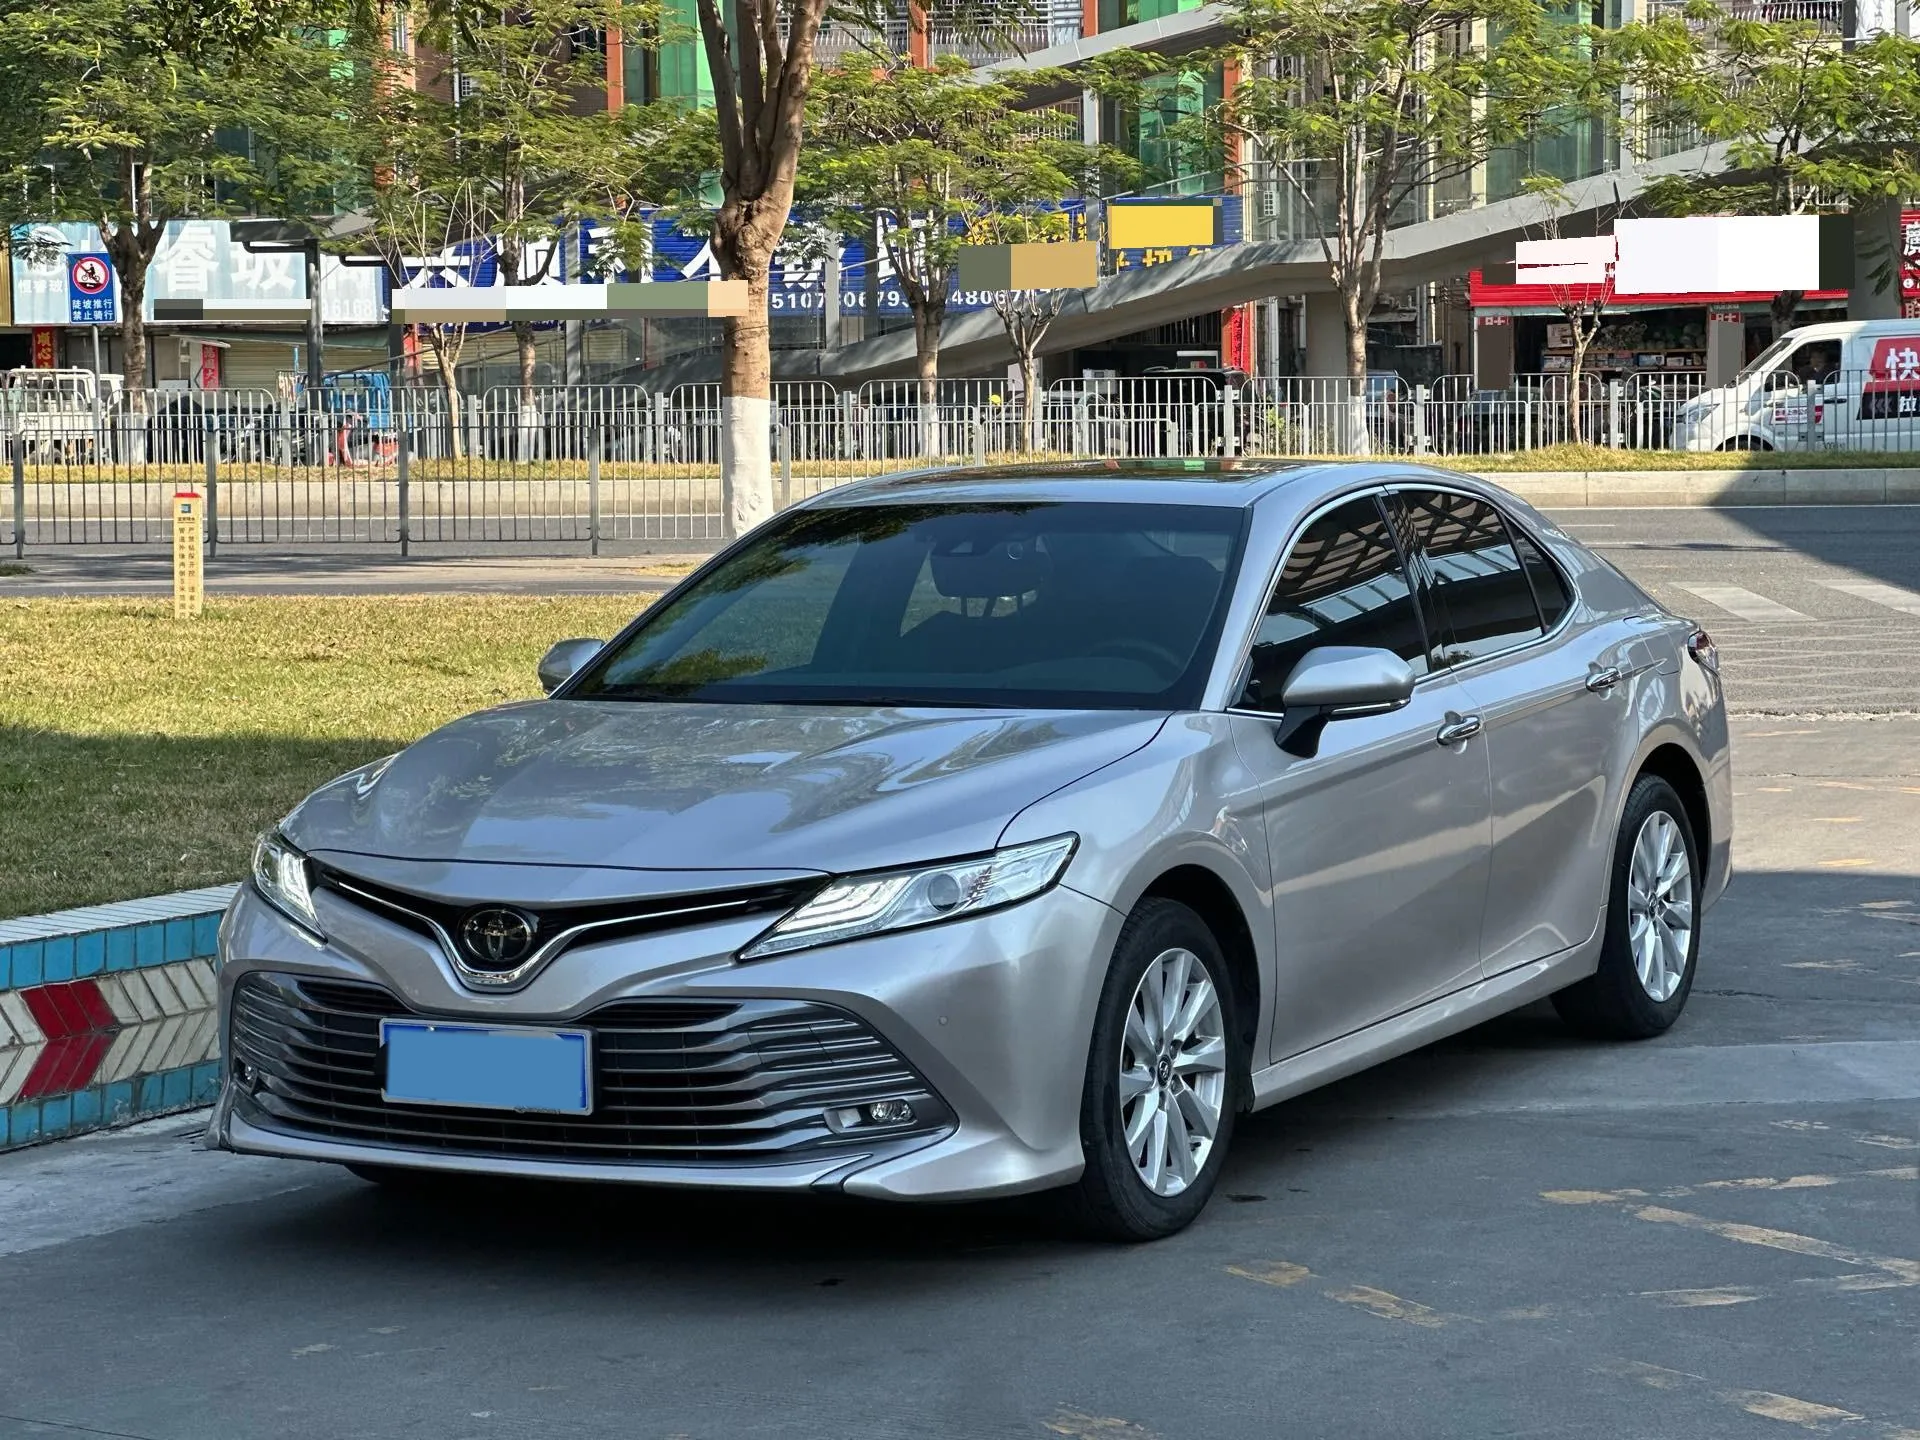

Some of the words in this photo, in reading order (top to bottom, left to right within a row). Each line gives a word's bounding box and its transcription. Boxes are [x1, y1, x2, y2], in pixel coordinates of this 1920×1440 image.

[72, 299, 112, 310] 陡坡推行
[73, 311, 113, 321] 禁止骑行
[1885, 347, 1920, 381] 快
